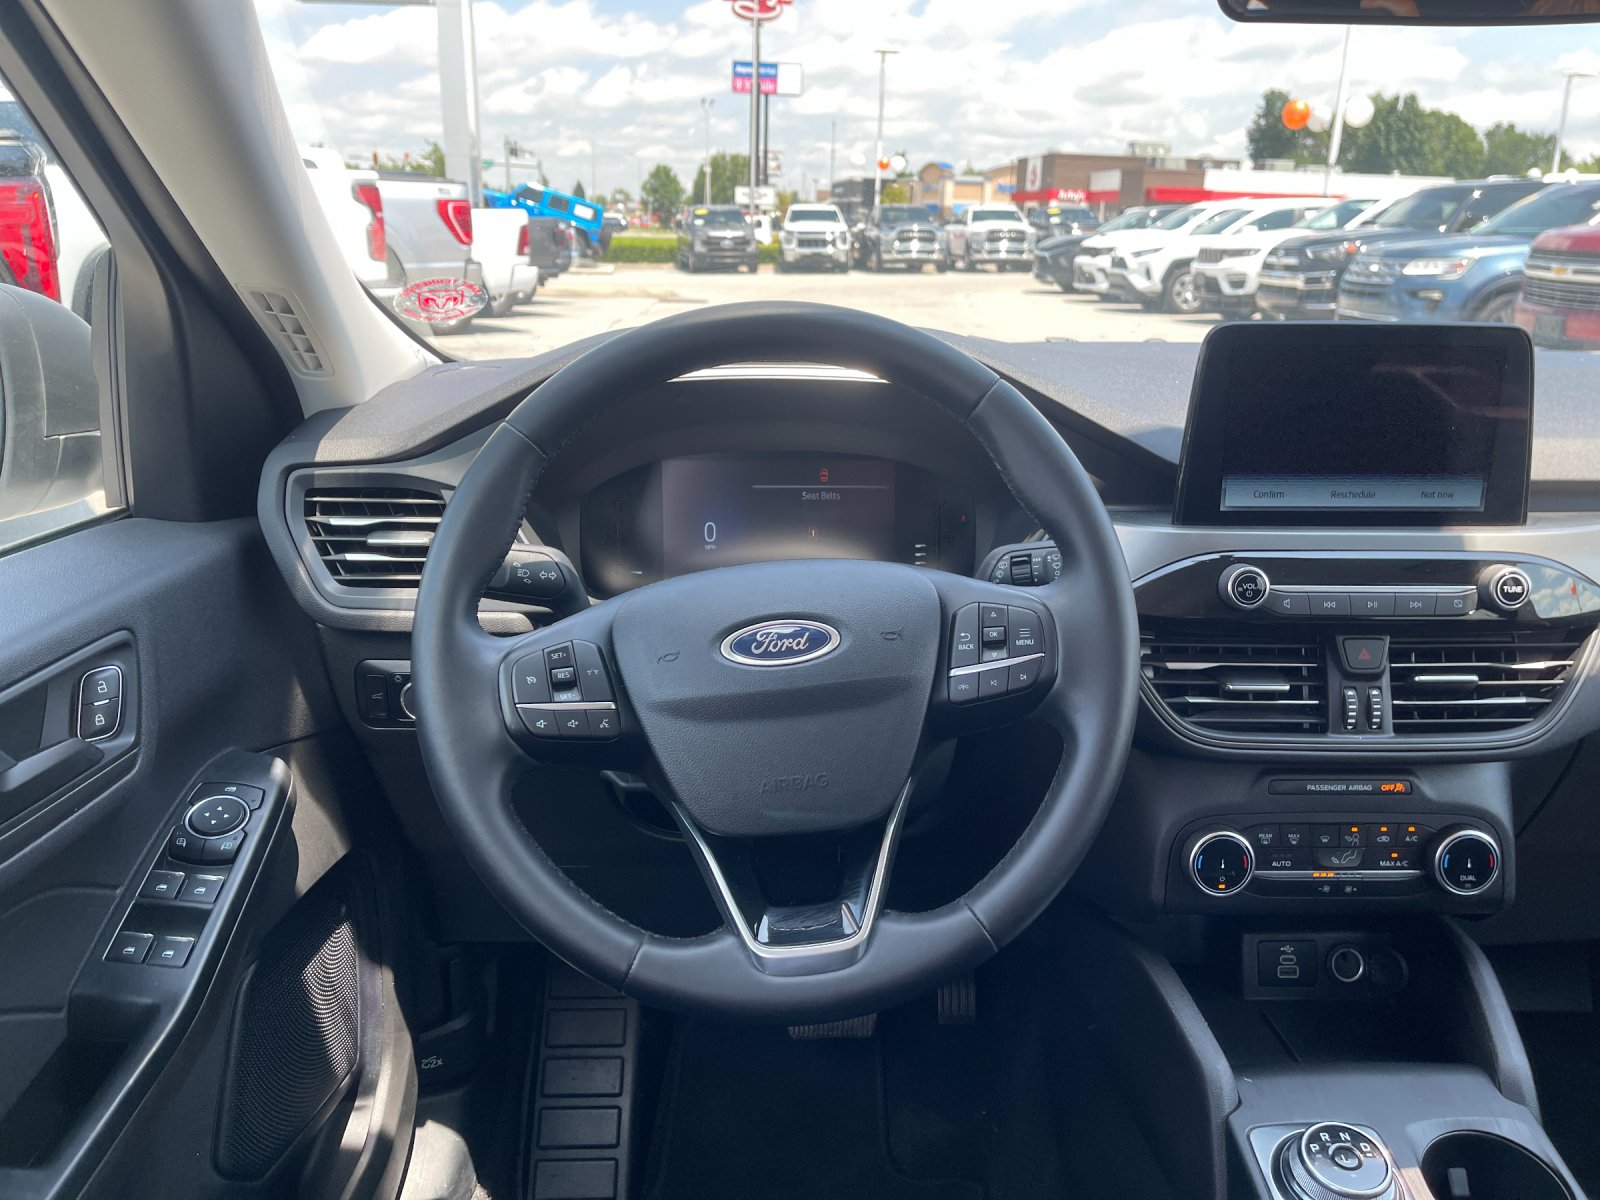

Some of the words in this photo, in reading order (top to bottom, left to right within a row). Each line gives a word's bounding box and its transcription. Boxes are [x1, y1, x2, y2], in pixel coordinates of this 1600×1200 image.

[801, 491, 819, 500] Seat
[820, 491, 841, 500] Belts
[1253, 489, 1285, 499] Confirm
[1330, 489, 1376, 499] Reschedule
[1421, 490, 1436, 499] Not
[1437, 491, 1455, 499] now
[704, 521, 717, 542] 0
[1502, 585, 1524, 593] TUNE
[751, 625, 809, 655] Ford
[1015, 638, 1034, 646] MENU
[958, 643, 974, 651] BACK
[557, 671, 571, 679] RES
[1380, 783, 1395, 792] OFF
[1309, 1143, 1319, 1153] P
[1319, 1132, 1330, 1142] R
[1339, 1132, 1351, 1141] N
[1360, 1142, 1371, 1151] D
